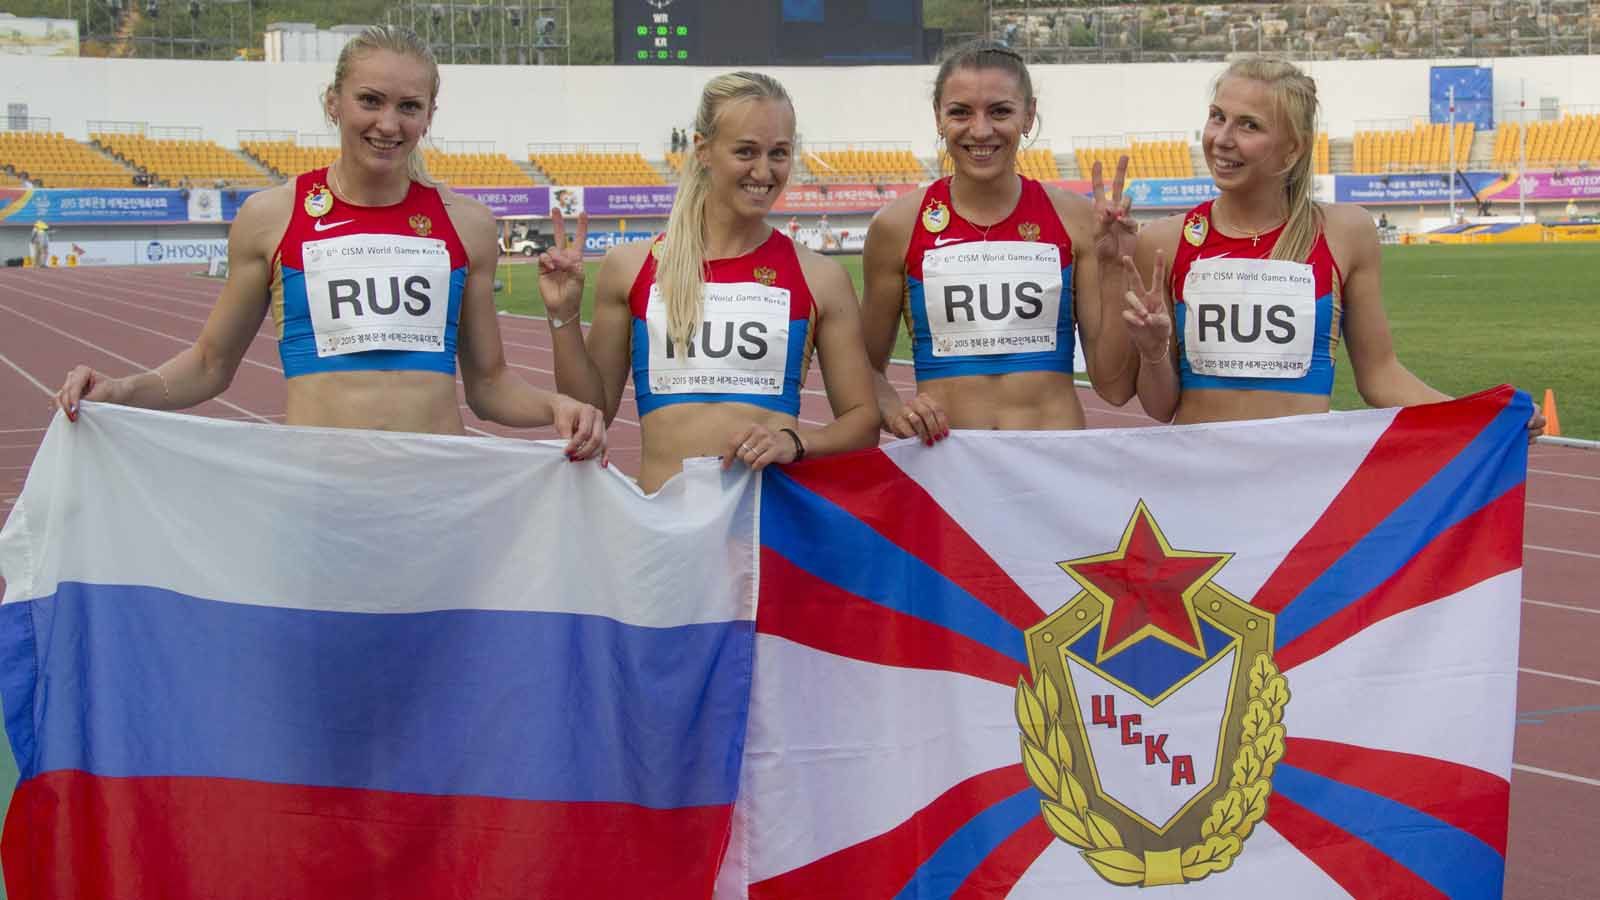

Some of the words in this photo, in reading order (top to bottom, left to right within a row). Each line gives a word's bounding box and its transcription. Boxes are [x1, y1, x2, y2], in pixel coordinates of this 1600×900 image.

[341, 247, 364, 256] CISM
[367, 246, 391, 255] World
[394, 246, 420, 255] Games
[958, 254, 979, 263] CISM
[982, 254, 1005, 262] World
[1008, 254, 1033, 262] Games
[1035, 254, 1057, 263] Korea
[1213, 272, 1233, 281] CISM
[1236, 273, 1259, 281] World
[1261, 274, 1287, 283] Games
[1289, 275, 1312, 284] Korea
[328, 275, 432, 320] RUS
[710, 295, 733, 303] World
[736, 294, 761, 302] Games
[944, 281, 1043, 323] RUS
[1198, 303, 1296, 345] RUS
[341, 335, 357, 345] 2015
[954, 338, 969, 348] 2015
[672, 376, 687, 385] 2015
[1091, 694, 1196, 786] ЦСКА
